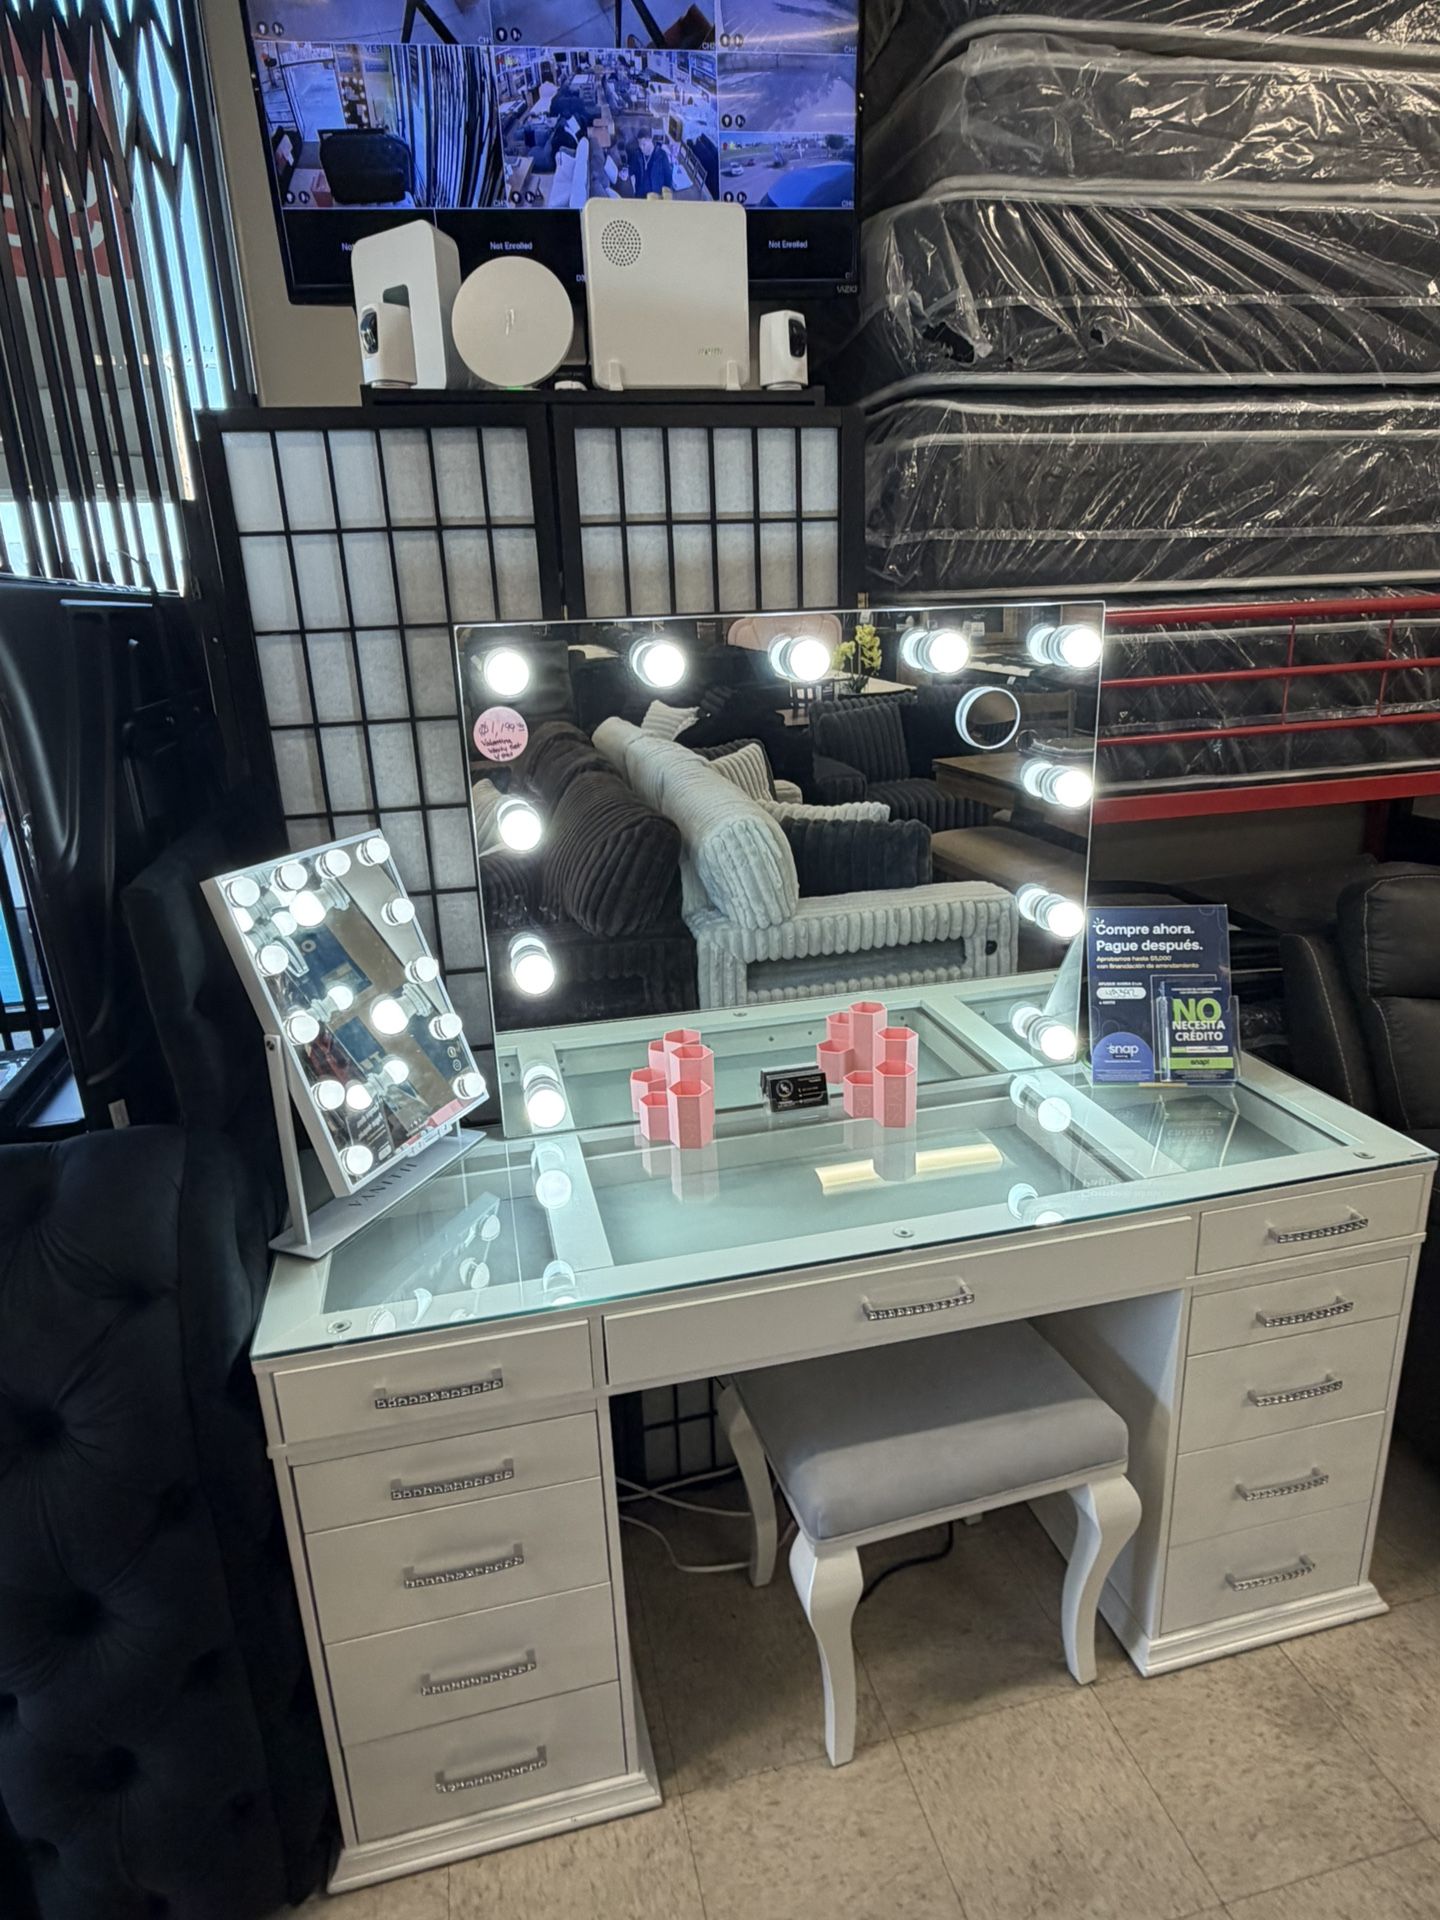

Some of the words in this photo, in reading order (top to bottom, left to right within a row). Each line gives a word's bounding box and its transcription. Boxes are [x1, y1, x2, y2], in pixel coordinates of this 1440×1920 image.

[341, 242, 354, 251] No
[489, 241, 503, 250] Not
[504, 240, 533, 251] Enrolled
[768, 240, 781, 249] Not
[782, 239, 808, 249] Enrolled
[1095, 924, 1150, 938] Compre
[1152, 923, 1195, 935] ahora.
[1096, 940, 1139, 954] Pague
[1141, 939, 1204, 953] después.
[1172, 997, 1222, 1024] NO
[1172, 1020, 1226, 1030] NECESITA
[1175, 1029, 1224, 1042] CRÉDITO
[1108, 1044, 1139, 1057] snap
